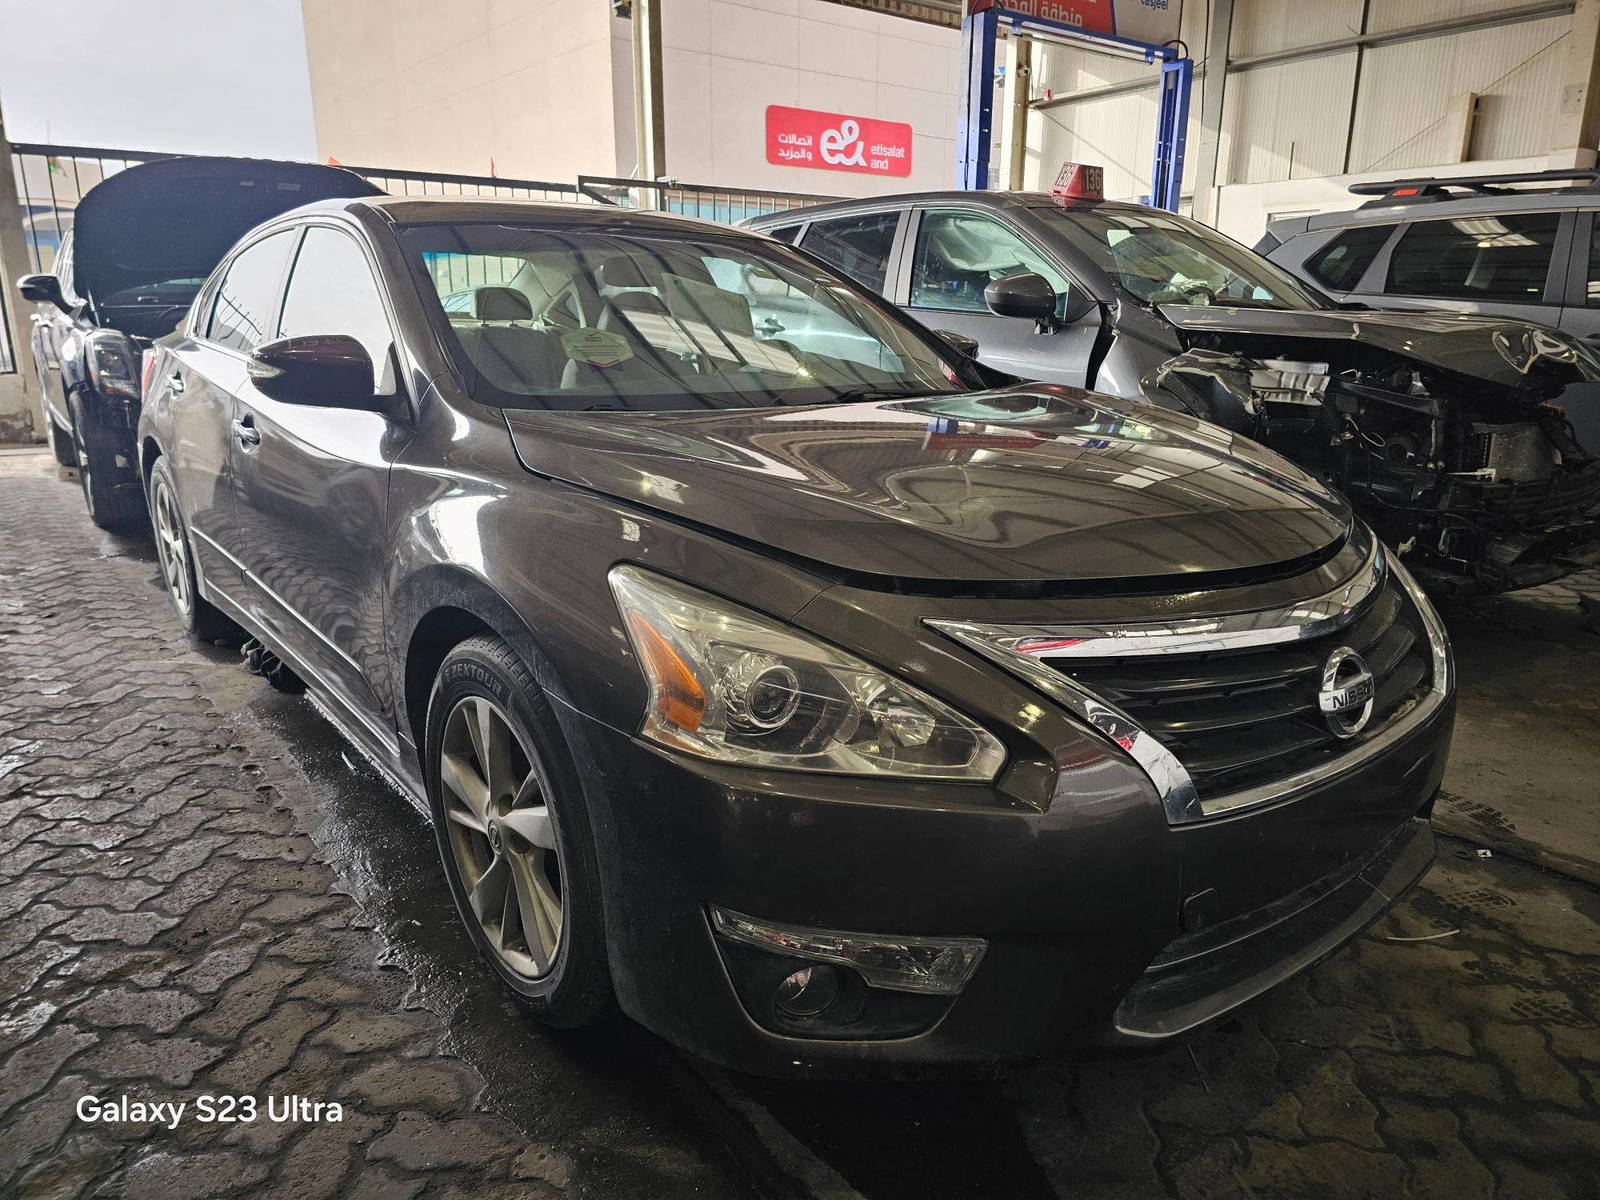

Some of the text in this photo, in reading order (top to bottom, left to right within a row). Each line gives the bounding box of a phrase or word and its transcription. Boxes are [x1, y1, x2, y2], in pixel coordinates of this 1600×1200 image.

[993, 0, 1083, 27] منطقة الفح
[778, 133, 812, 146] اتصالات
[871, 144, 905, 158] etisalat
[871, 159, 889, 169] and
[1085, 168, 1101, 191] 136
[451, 663, 501, 697] ZEXTOUR
